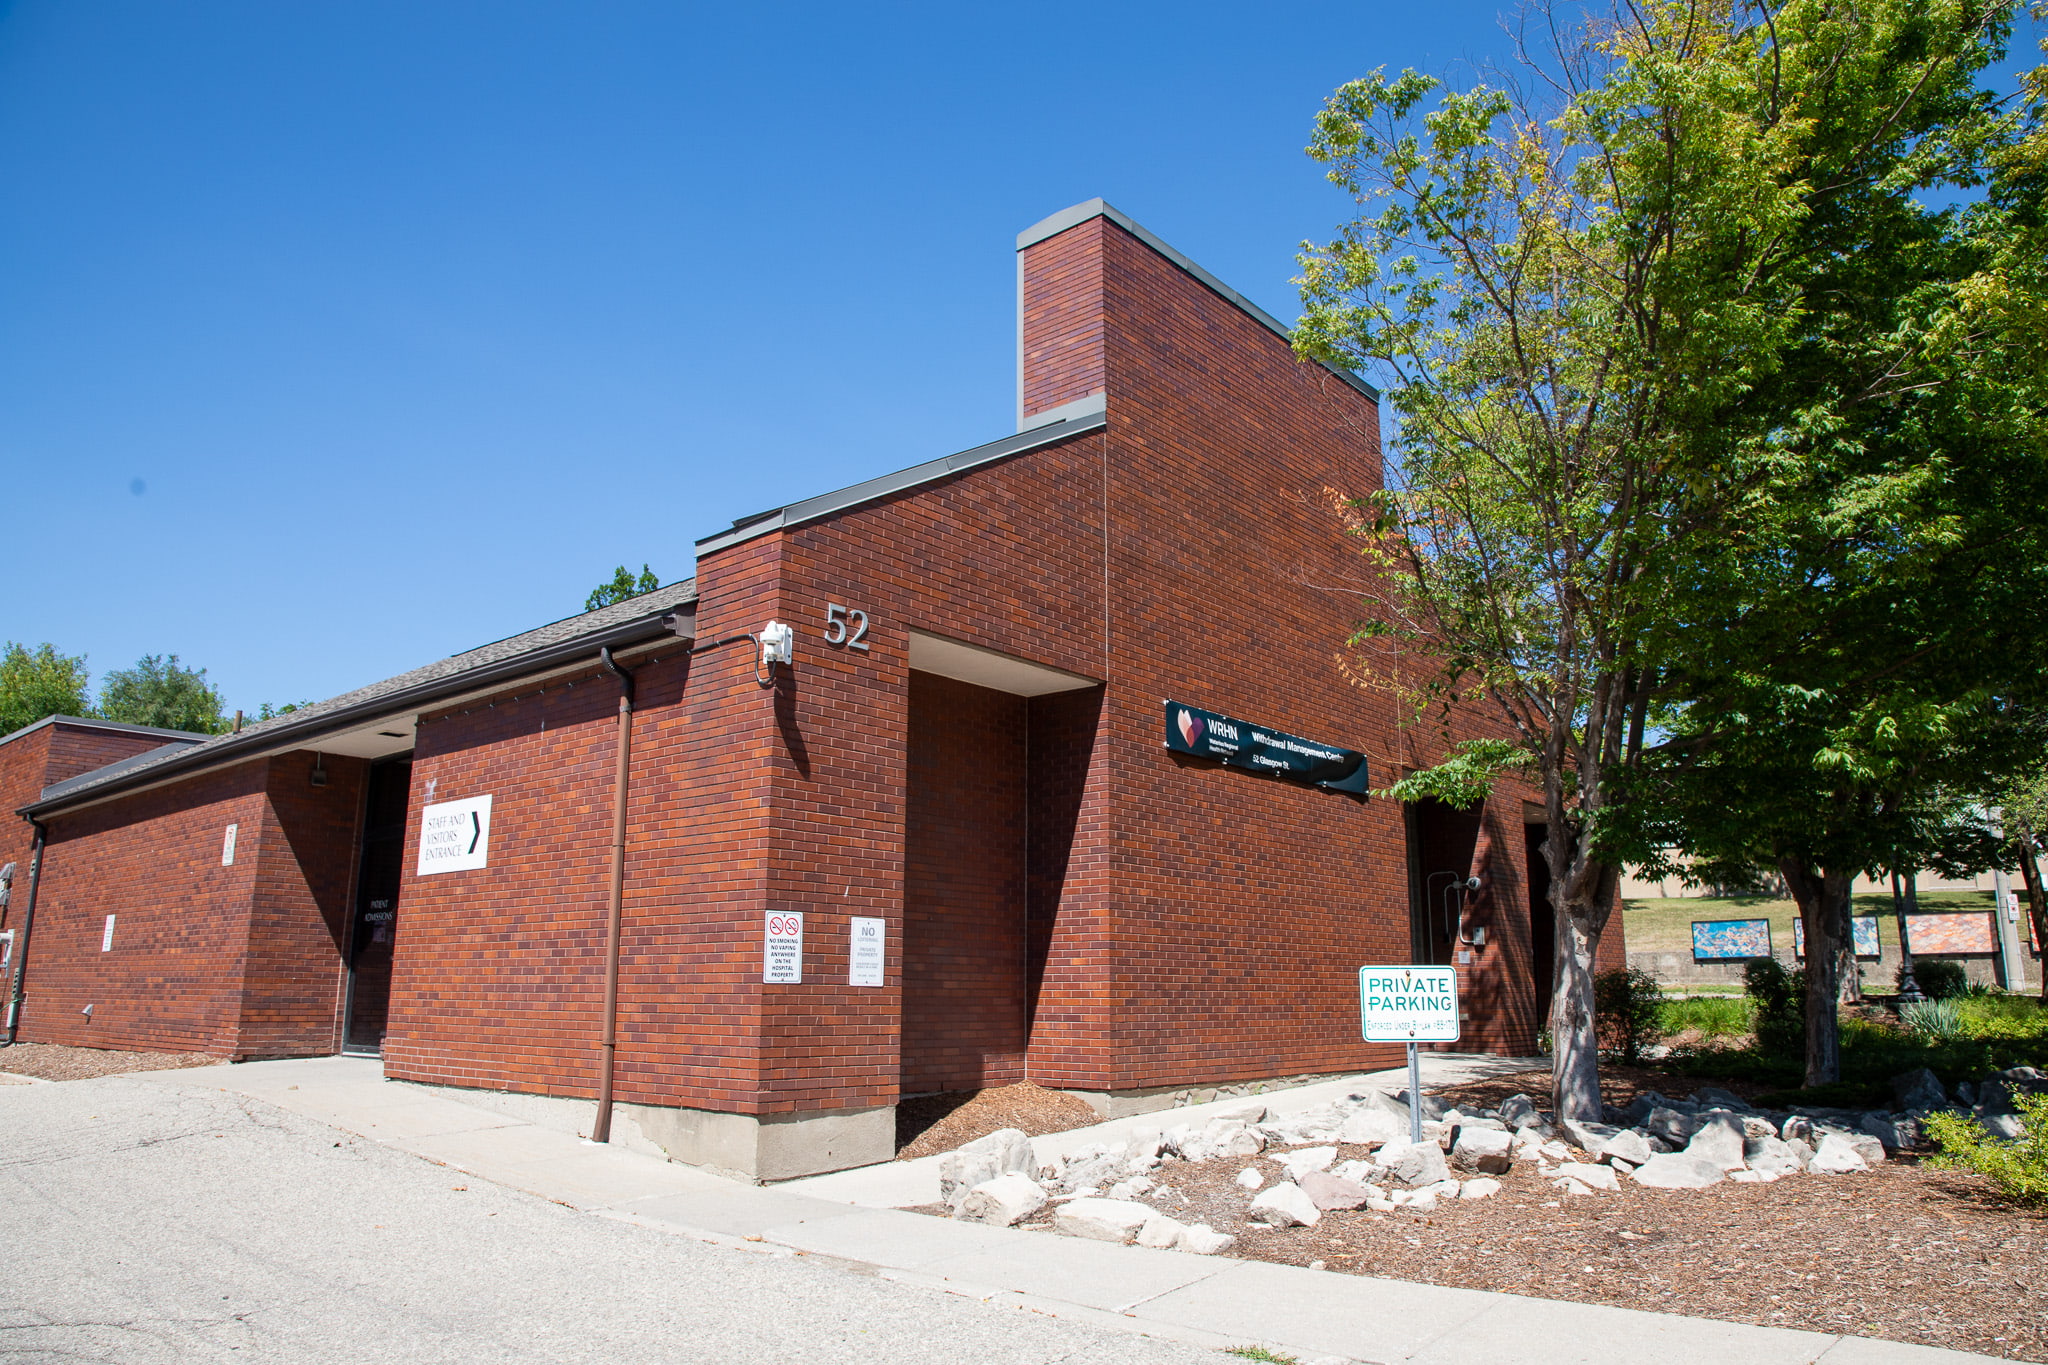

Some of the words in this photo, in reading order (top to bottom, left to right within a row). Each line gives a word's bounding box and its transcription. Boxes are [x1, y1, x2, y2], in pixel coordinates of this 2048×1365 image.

[825, 602, 869, 650] 52
[1207, 718, 1238, 740] WRHN
[1251, 731, 1286, 749] Withdrawal
[1287, 740, 1326, 758] Management
[1252, 754, 1259, 763] 52
[1260, 756, 1282, 768] Glasgow
[428, 816, 448, 830] STAFF
[449, 813, 466, 826] AND
[427, 830, 458, 845] VISITORS
[425, 844, 462, 861] ENTRANCE
[861, 927, 876, 936] NO
[1369, 978, 1449, 993] PRIVATE
[1369, 996, 1452, 1011] PARKING
